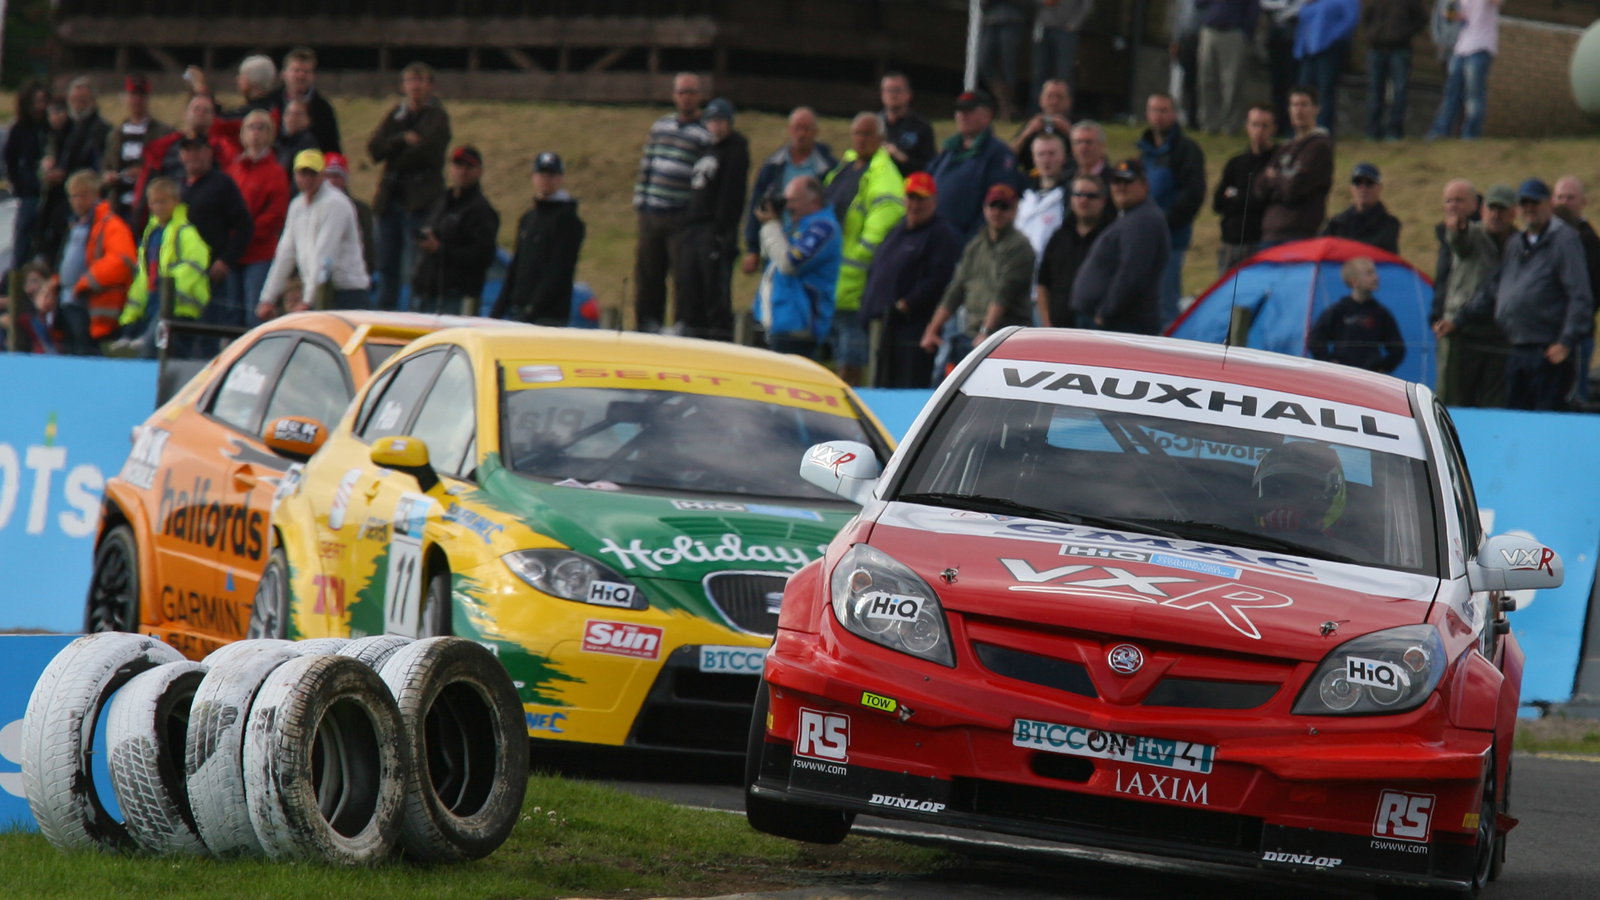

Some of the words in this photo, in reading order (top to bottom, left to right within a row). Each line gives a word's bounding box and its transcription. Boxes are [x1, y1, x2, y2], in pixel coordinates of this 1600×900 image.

[573, 368, 731, 386] SEAT
[752, 381, 839, 408] TDI
[1002, 367, 1400, 440] VAUXHALL
[811, 444, 857, 479] VXR
[156, 467, 263, 562] halfords
[600, 533, 812, 572] Holiday
[1006, 523, 1314, 574] GMAC
[1069, 546, 1146, 561] HiQ
[1501, 547, 1555, 577] VXR
[390, 553, 416, 625] 11
[591, 584, 630, 602] HiQ
[999, 558, 1294, 639] VXR
[162, 585, 242, 638] GARMIN
[871, 596, 918, 619] HiQ
[585, 623, 659, 651] Sun
[703, 651, 763, 670] BTCC
[1349, 660, 1395, 686] HiQ
[866, 694, 891, 708] TOW
[798, 711, 847, 759] RS
[1138, 736, 1173, 761] itv
[1181, 742, 1196, 767] 4
[793, 759, 847, 776] rswww.com
[868, 793, 946, 813] DUNLOP
[1376, 792, 1432, 838] RS
[1262, 851, 1342, 868] DUNLOP
[1370, 839, 1428, 854] rswww.com
